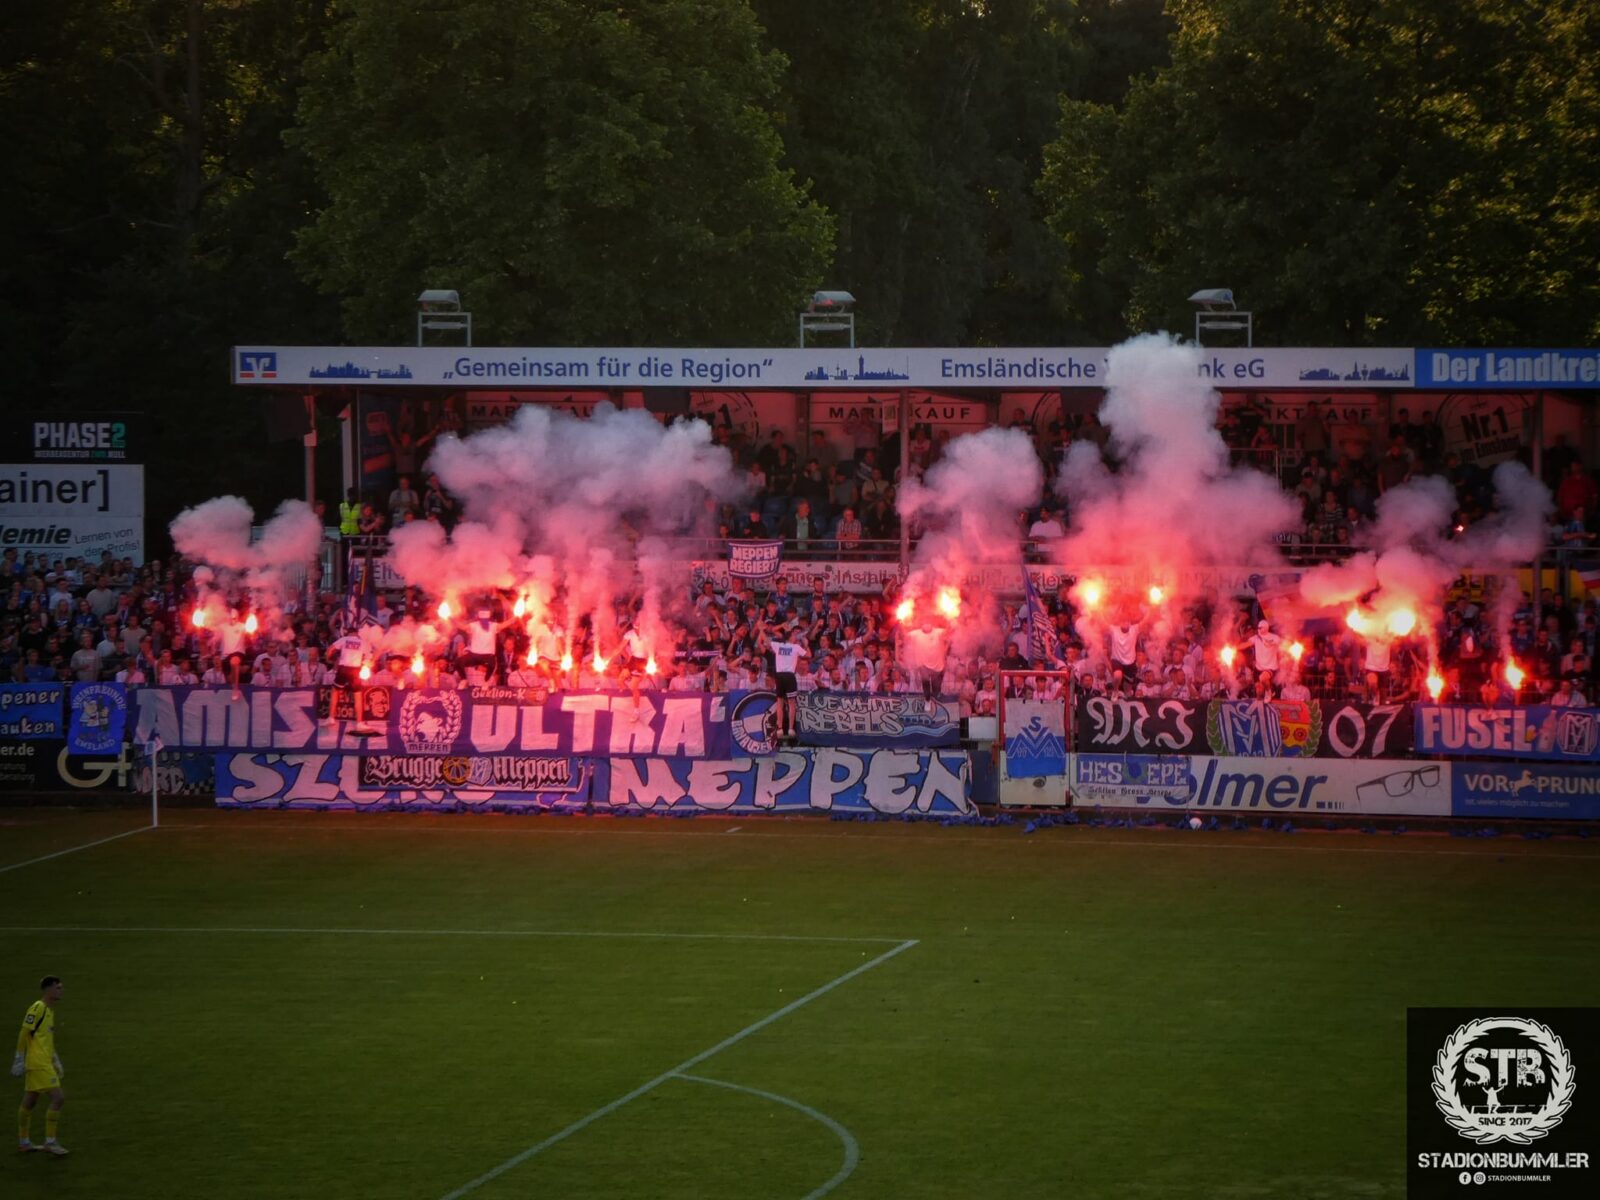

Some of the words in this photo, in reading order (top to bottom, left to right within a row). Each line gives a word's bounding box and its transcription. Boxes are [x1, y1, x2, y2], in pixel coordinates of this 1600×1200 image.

[597, 356, 632, 377] für
[639, 356, 674, 377] die
[941, 357, 1097, 378] Emsländische
[1233, 358, 1265, 378] eG
[1432, 353, 1480, 381] Der
[34, 422, 126, 448] PHASE2
[1461, 406, 1508, 442] Nr.1
[75, 533, 112, 545] Lernen
[113, 527, 134, 538] von
[732, 546, 778, 560] MEPPEN
[797, 708, 904, 736] REBELS
[1328, 704, 1404, 758] 07
[1421, 706, 1532, 751] FUSEL
[366, 757, 443, 787] Brugge
[493, 757, 571, 789] Meppen
[607, 750, 971, 814] MEPPEN
